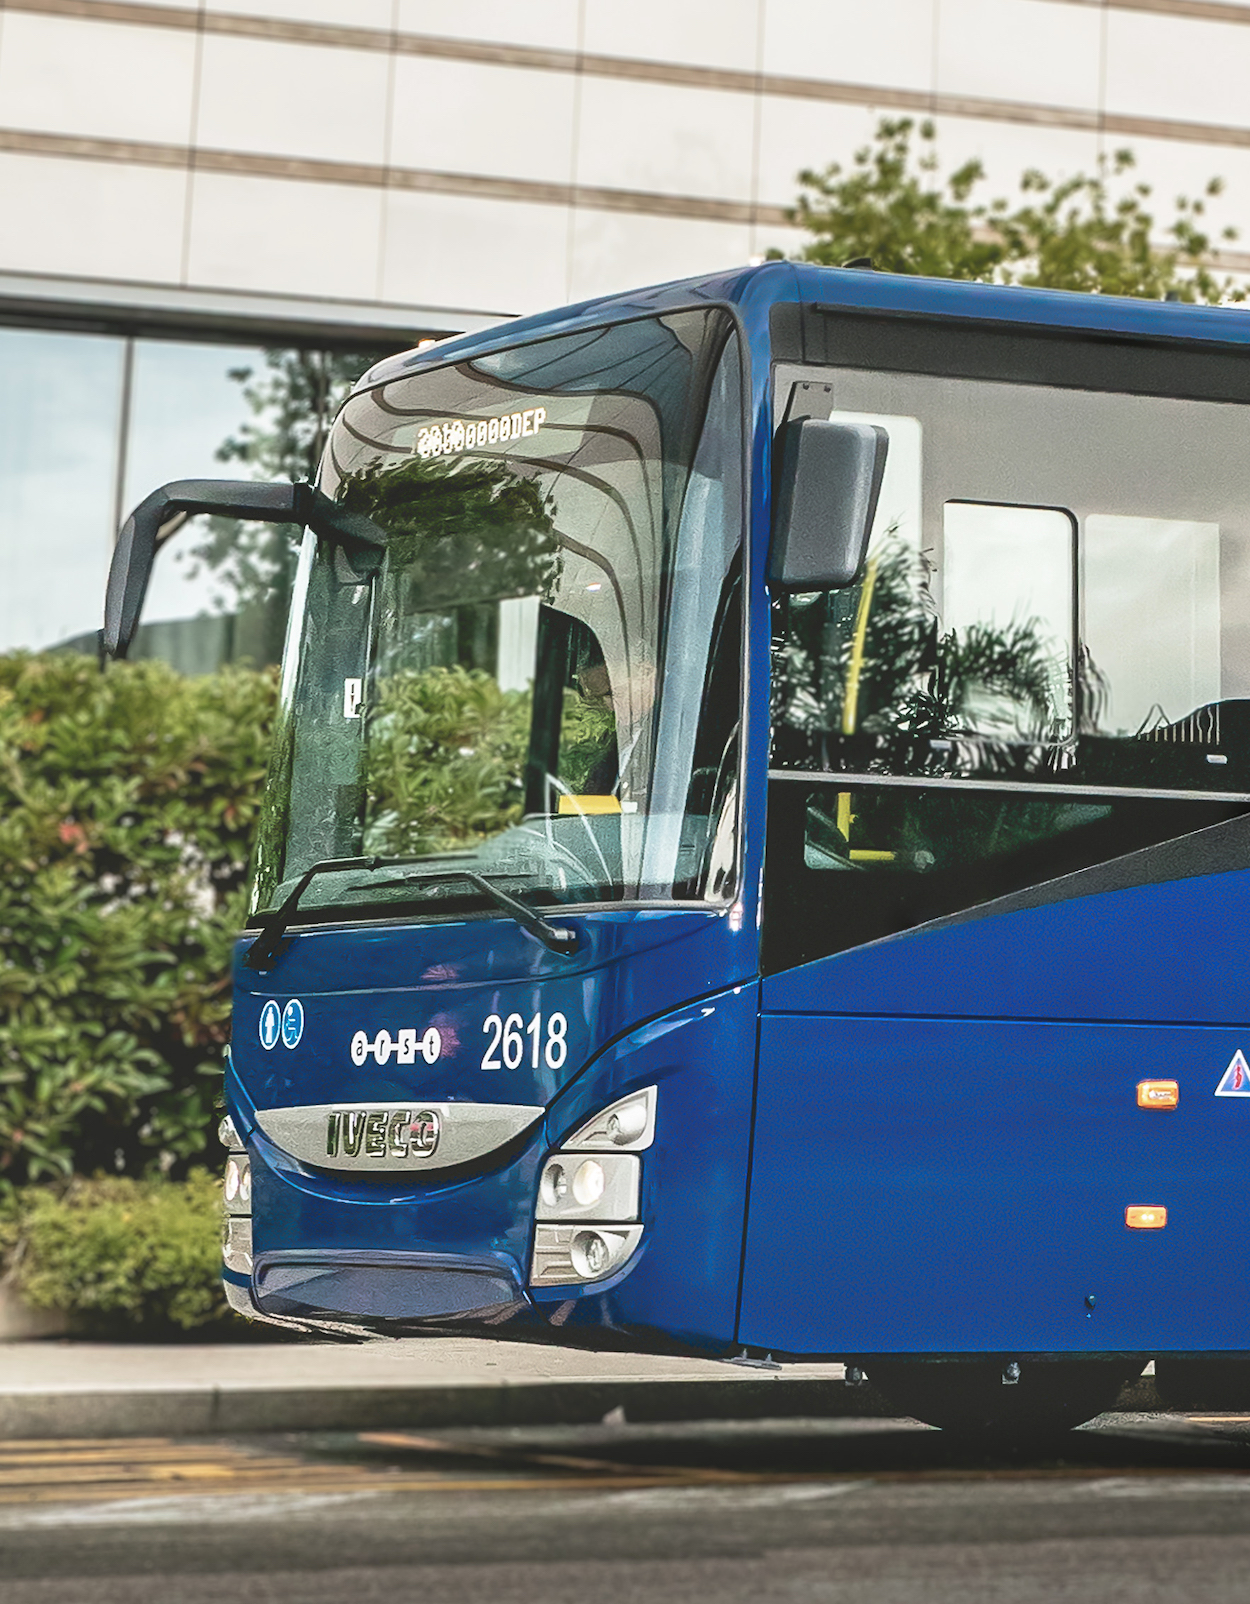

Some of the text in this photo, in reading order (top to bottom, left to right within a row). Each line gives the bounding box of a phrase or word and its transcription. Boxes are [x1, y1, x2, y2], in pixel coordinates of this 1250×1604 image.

[353, 1033, 438, 1058] arst
[481, 1012, 568, 1070] 2618
[326, 1110, 441, 1158] IVECO
